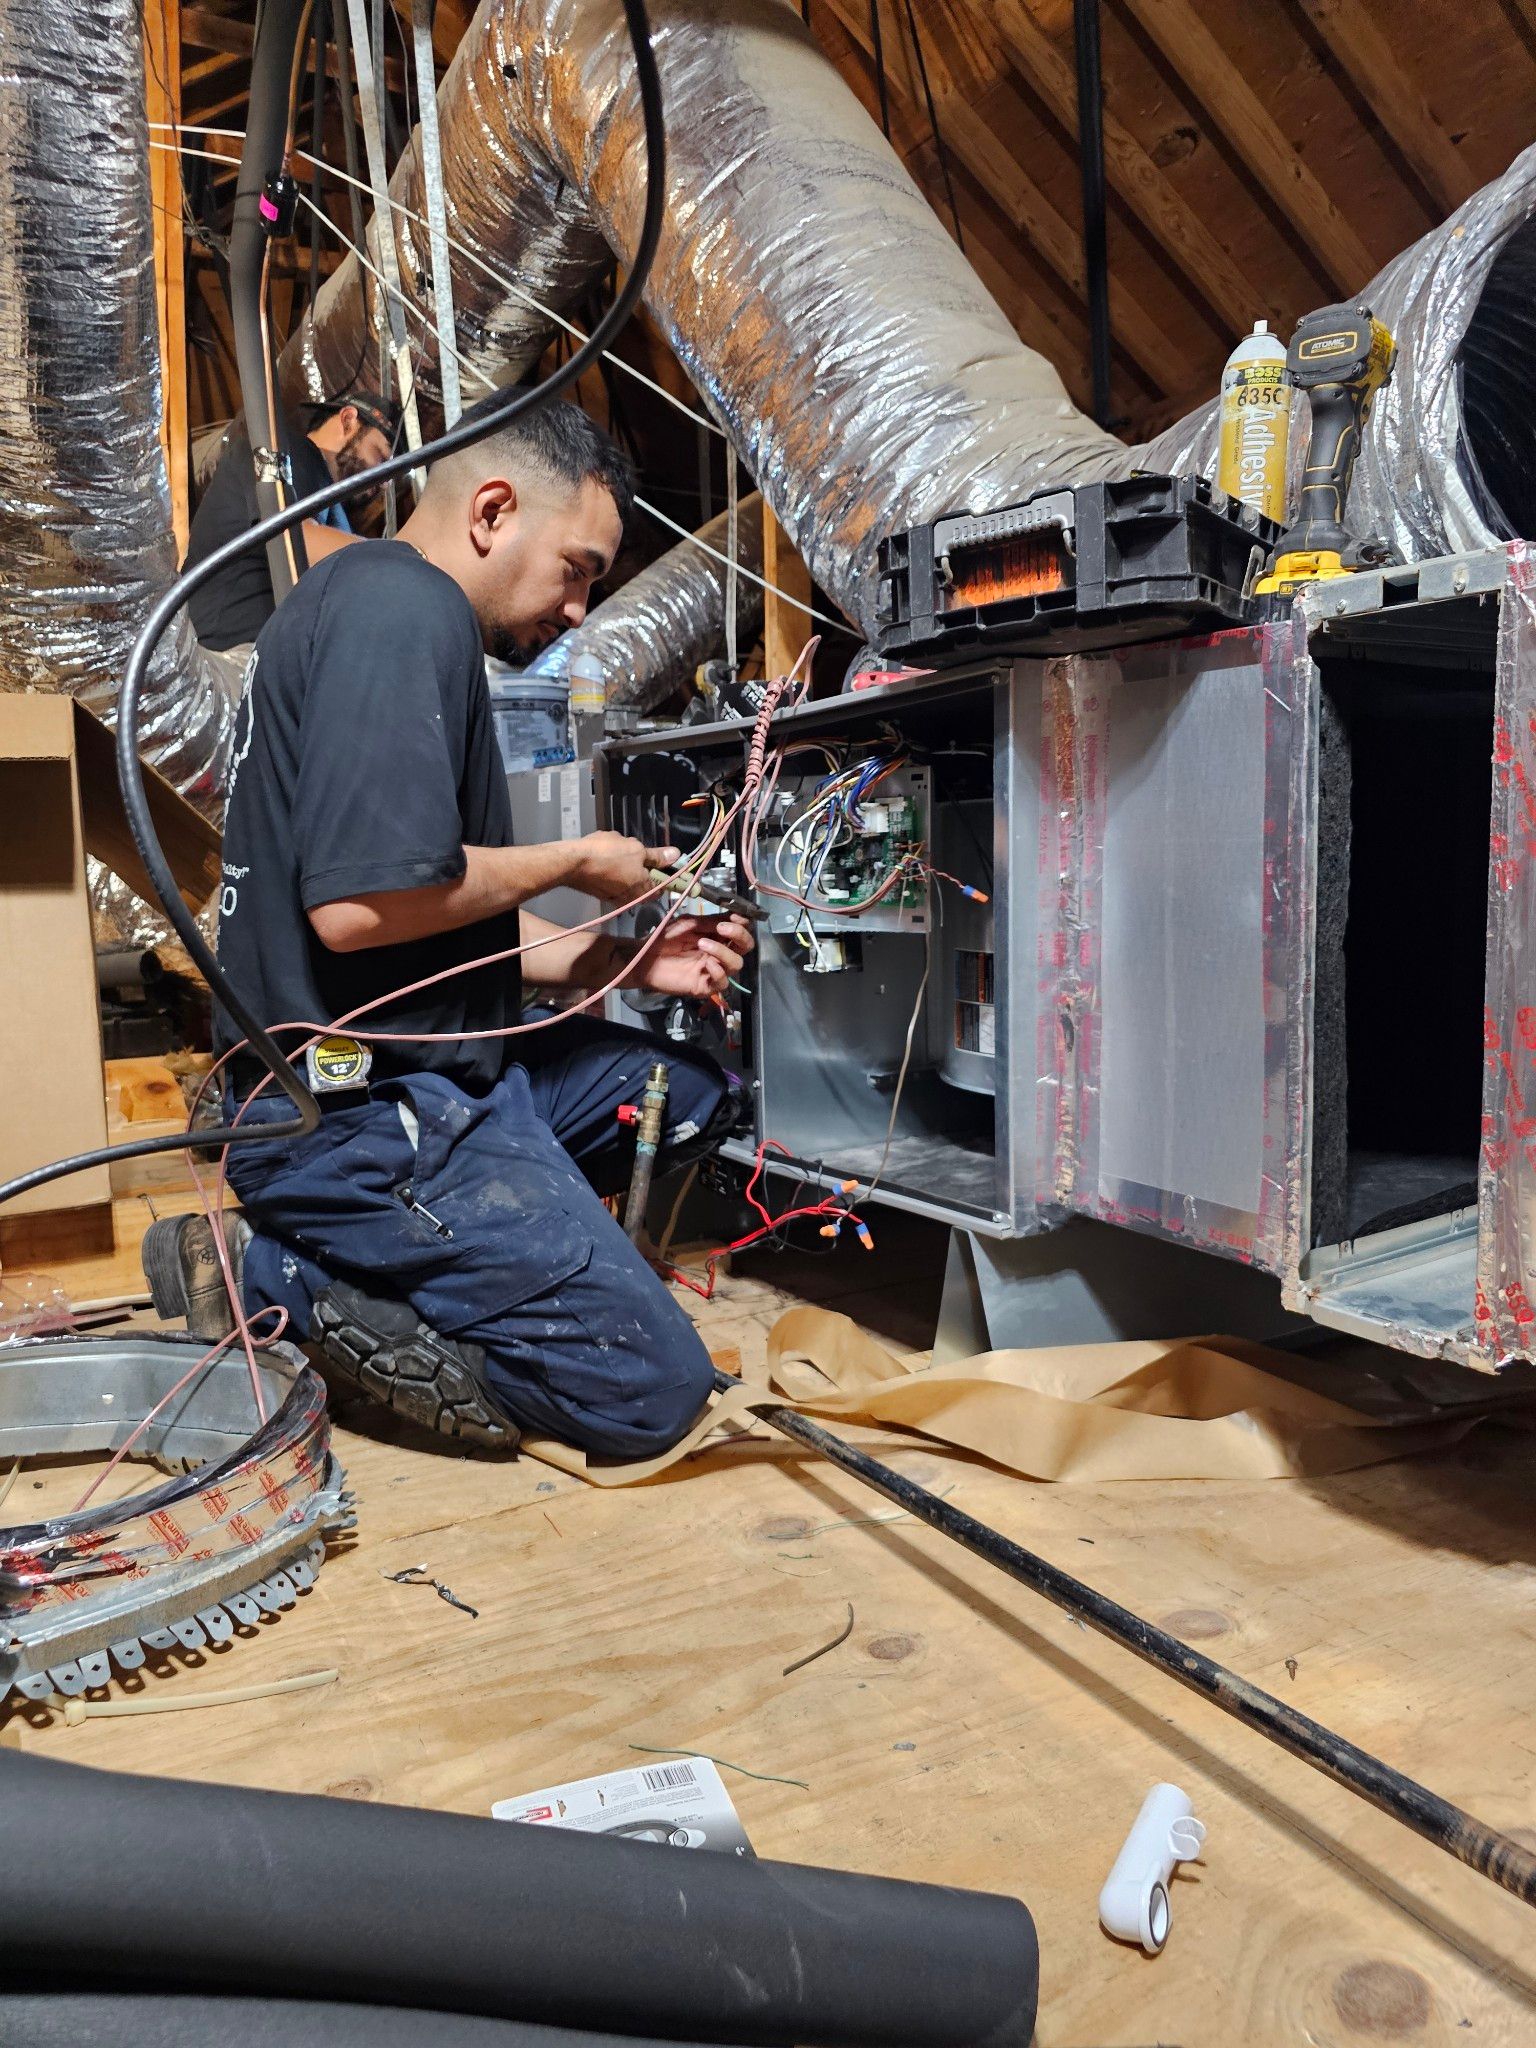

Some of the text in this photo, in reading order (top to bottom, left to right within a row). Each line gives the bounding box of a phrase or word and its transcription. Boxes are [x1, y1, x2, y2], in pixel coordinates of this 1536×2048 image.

[1311, 338, 1345, 350] ATOMIC
[1245, 367, 1281, 378] BOSS
[1240, 408, 1276, 513] Adhesiv
[319, 1053, 358, 1065] POWERLOCK
